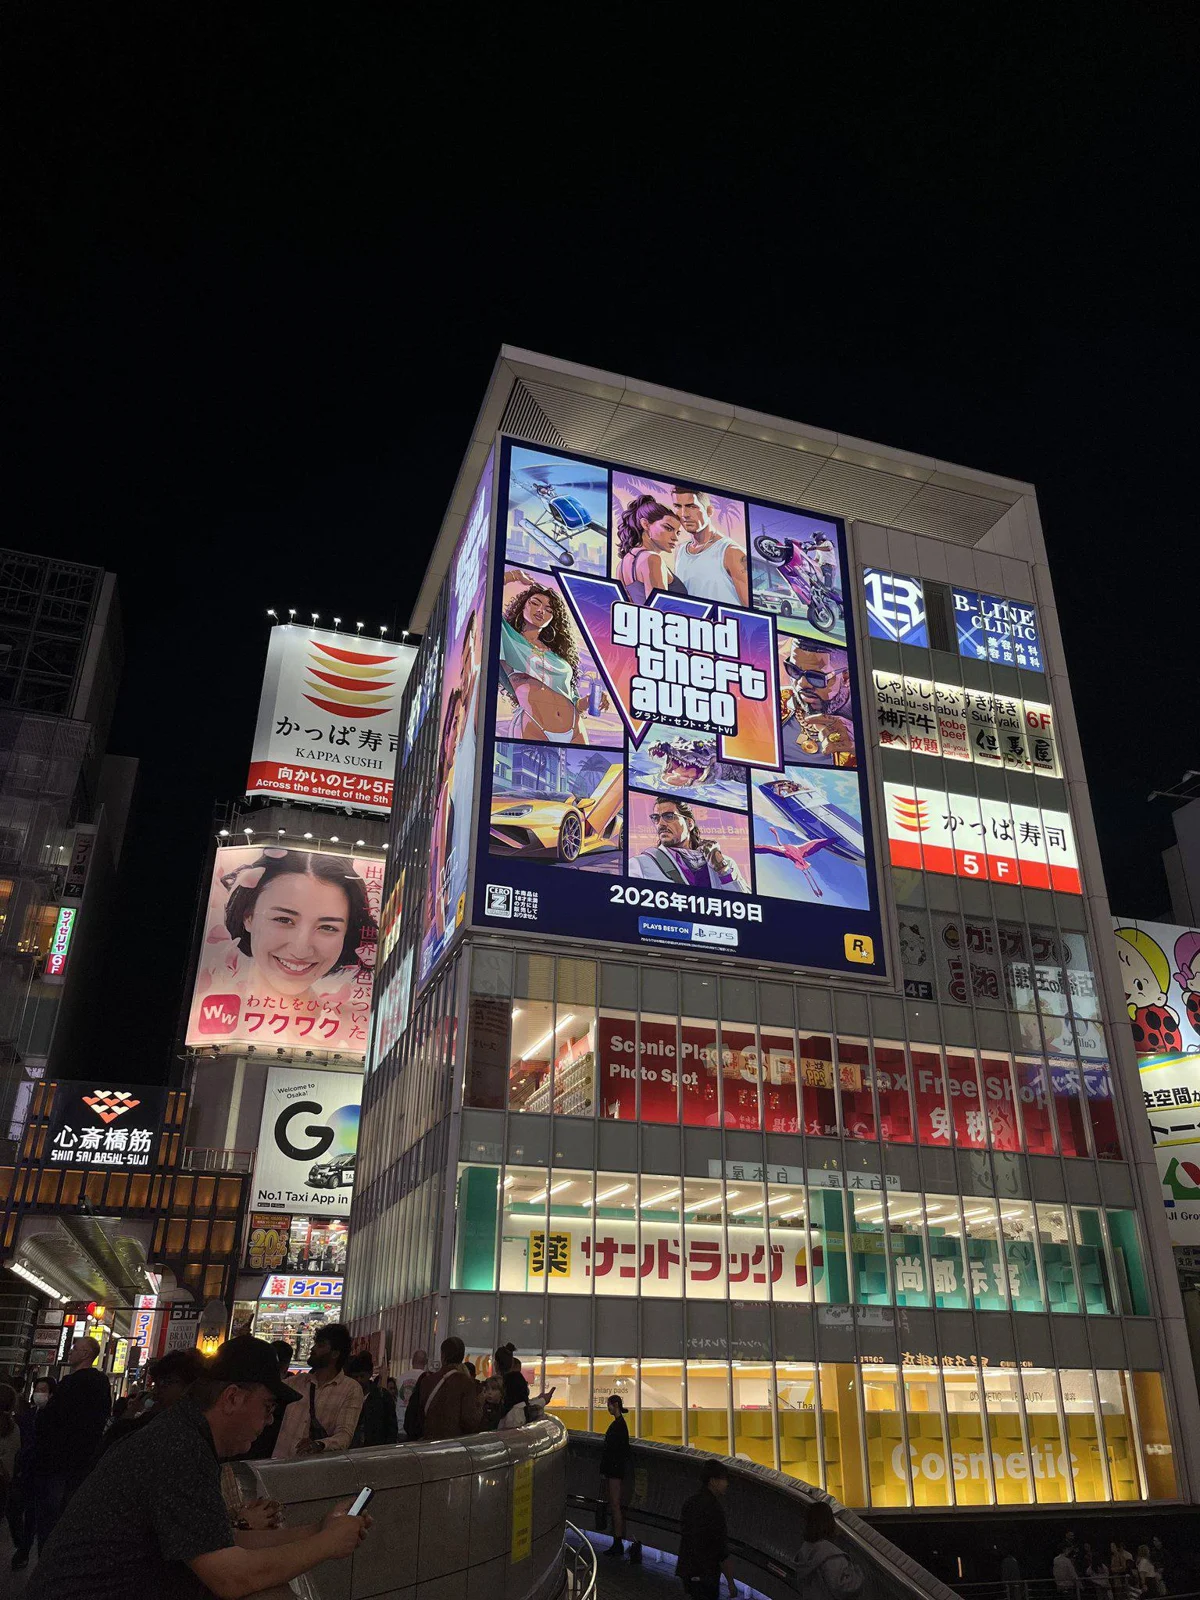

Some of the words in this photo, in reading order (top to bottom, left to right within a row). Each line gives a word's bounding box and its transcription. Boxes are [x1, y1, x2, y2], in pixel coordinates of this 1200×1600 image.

[953, 593, 1035, 627] B-LINE
[971, 615, 1037, 641] CLINIC
[976, 645, 1041, 668] 美容皮膚科
[987, 636, 1039, 656] 美容外科
[637, 645, 765, 701] theft
[631, 676, 736, 728] auto
[877, 706, 937, 735] 神戸牛
[939, 717, 966, 731] kobe
[1026, 711, 1052, 730] 6F
[878, 730, 939, 755] 食べ放題
[941, 728, 966, 741] beef
[296, 747, 341, 764] KAPPA
[343, 755, 383, 770] SUSHI
[255, 777, 292, 790] Across
[294, 783, 310, 793] the
[312, 785, 340, 797] street
[343, 789, 354, 799] of
[355, 790, 371, 802] the
[373, 793, 389, 804] 5th
[277, 766, 394, 794] 向かいのビル5F
[941, 813, 1067, 852] かっぱ寿司
[69, 884, 81, 894] 7F
[489, 887, 510, 896] CERO
[490, 894, 507, 910] Z
[609, 884, 763, 923] 2026年11月19日
[513, 912, 538, 920] おりません
[55, 910, 73, 952] サイゼリヤ
[642, 922, 662, 932] PLAYS
[663, 925, 679, 933] BEST
[679, 927, 690, 935] ON
[708, 930, 735, 941] PS5
[51, 955, 63, 974] 6F
[906, 982, 928, 997] 4F
[246, 995, 343, 1016] わたしをひらく
[244, 1012, 340, 1039] ワクワク
[609, 1034, 677, 1058] Scenic
[609, 1063, 658, 1082] Photo
[660, 1068, 699, 1087] Spot
[277, 1083, 307, 1094] Welcome
[286, 1090, 308, 1099] Osaka!
[918, 1069, 978, 1098] Free
[986, 1076, 1051, 1111] Shop
[53, 1124, 154, 1153] 心斎橋筋
[1148, 1118, 1200, 1145] トー
[50, 1149, 74, 1161] SHIN
[75, 1150, 92, 1162] SAI
[258, 1190, 282, 1201] No.1
[285, 1191, 309, 1202] Taxi
[311, 1193, 335, 1206] App
[338, 1194, 348, 1204] in
[250, 1229, 287, 1257] 20%
[532, 1234, 569, 1274] 薬
[251, 1255, 282, 1269] OFF
[581, 1237, 785, 1284] サンドラッグ
[270, 1276, 286, 1296] 薬
[292, 1279, 344, 1296] ダイコク
[168, 1339, 192, 1349] STORE
[169, 1331, 194, 1340] BRAND
[891, 1443, 1080, 1481] Cosmetic
